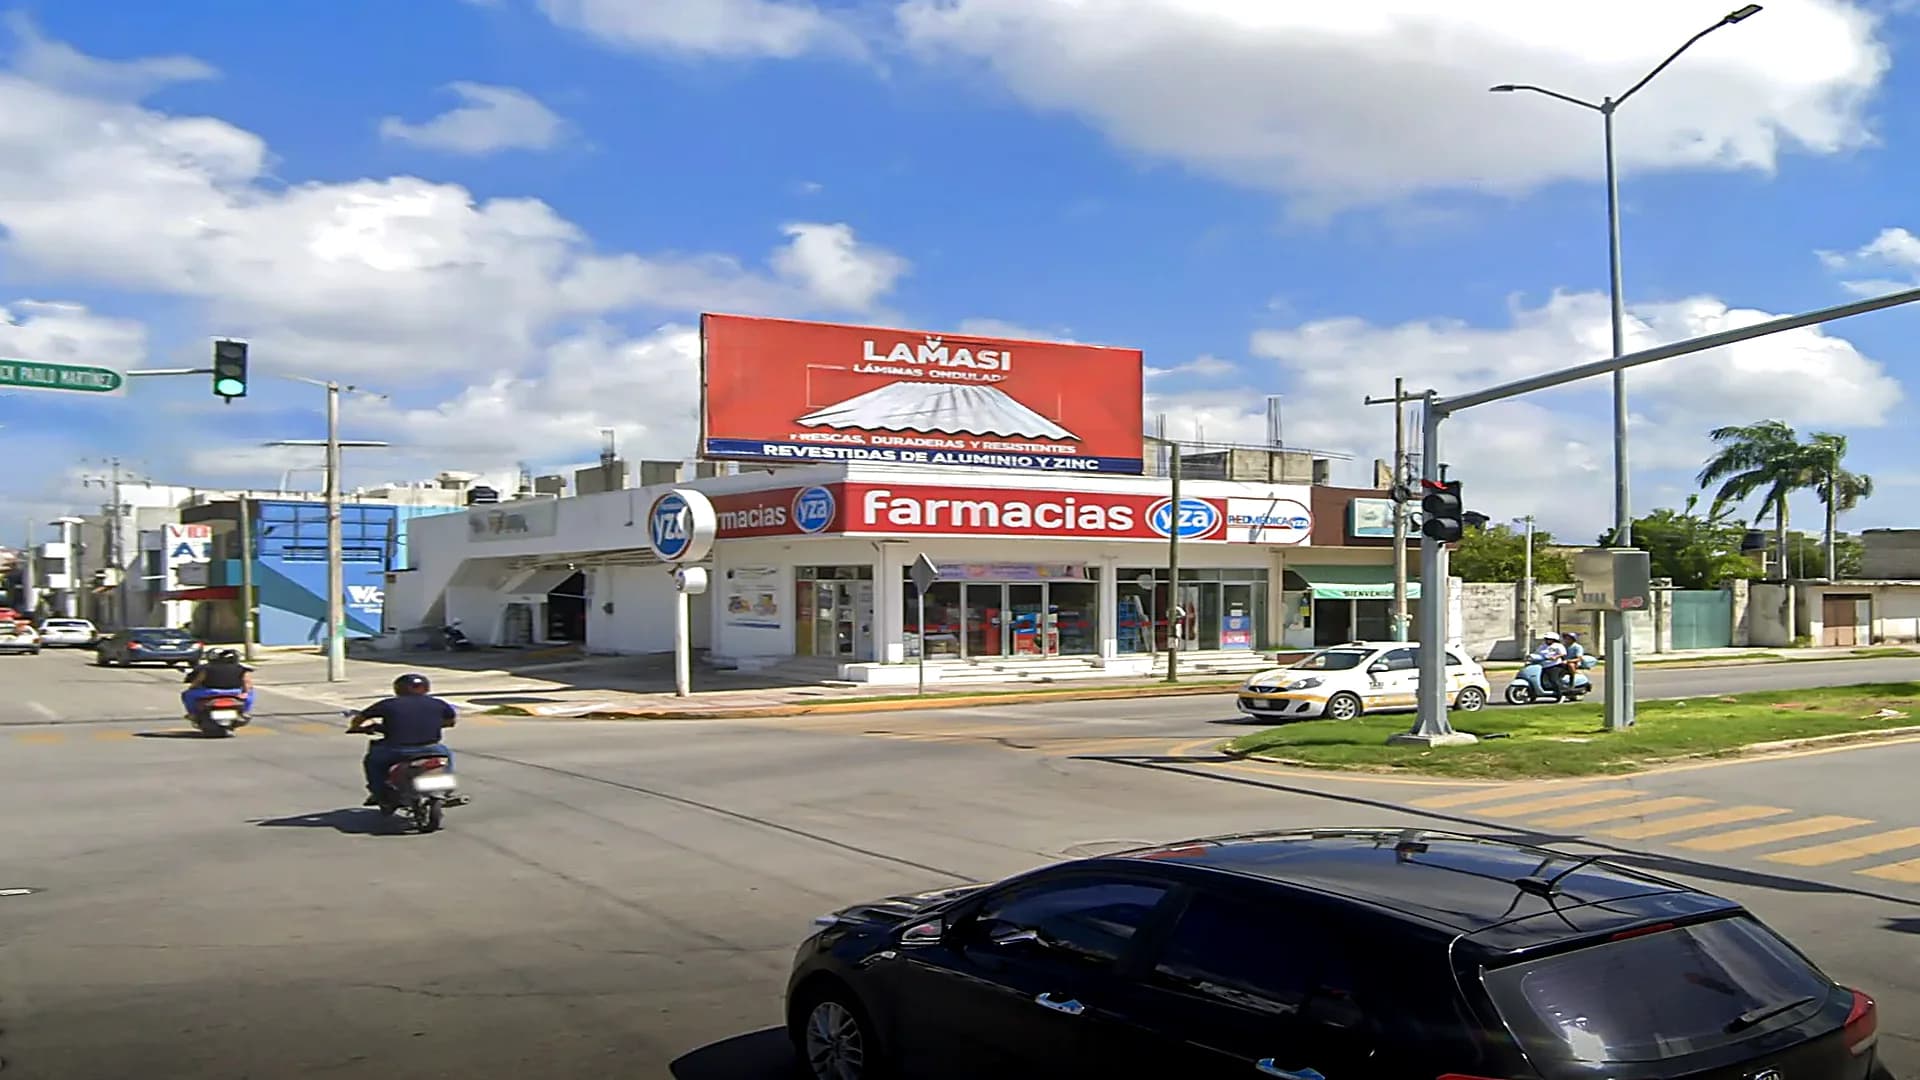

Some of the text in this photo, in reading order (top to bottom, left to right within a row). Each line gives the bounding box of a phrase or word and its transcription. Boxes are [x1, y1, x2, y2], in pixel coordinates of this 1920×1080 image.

[863, 336, 1011, 371] LAMASI
[852, 363, 923, 377] LÁMINAS
[763, 444, 1099, 470] REVESTIDAS DE ALUMINIO Y ZINC
[871, 436, 965, 449] DURADERAS
[969, 441, 980, 450] Y
[982, 442, 1076, 454] RESISTENTES
[718, 504, 787, 530] macias
[801, 499, 828, 523] yza
[1160, 508, 1209, 530] yza
